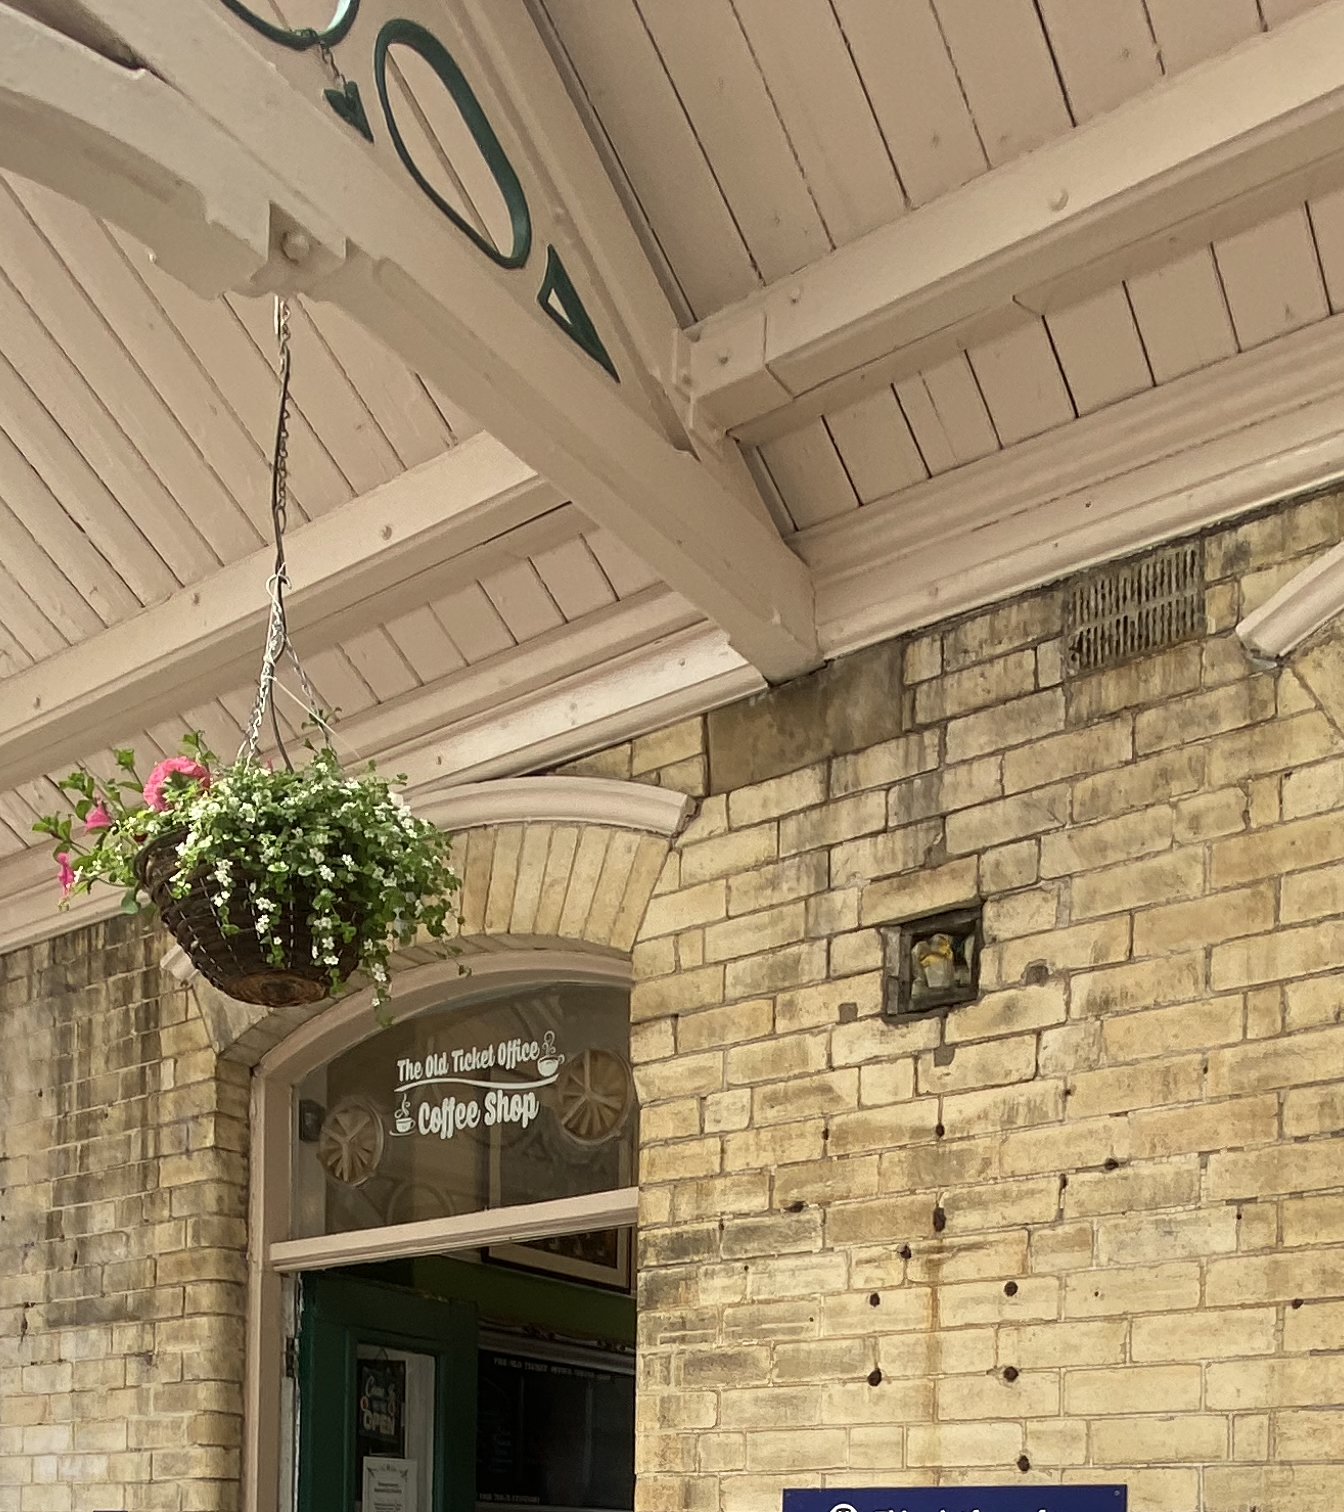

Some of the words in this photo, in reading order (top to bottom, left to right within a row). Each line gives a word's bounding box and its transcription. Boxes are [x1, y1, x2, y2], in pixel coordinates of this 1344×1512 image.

[397, 1058, 424, 1082] The
[425, 1051, 449, 1079] Old
[451, 1044, 496, 1073] Ticket
[497, 1038, 540, 1071] Office
[418, 1096, 481, 1140] Coffee
[484, 1089, 539, 1129] Shop
[363, 1412, 395, 1436] OPEN
